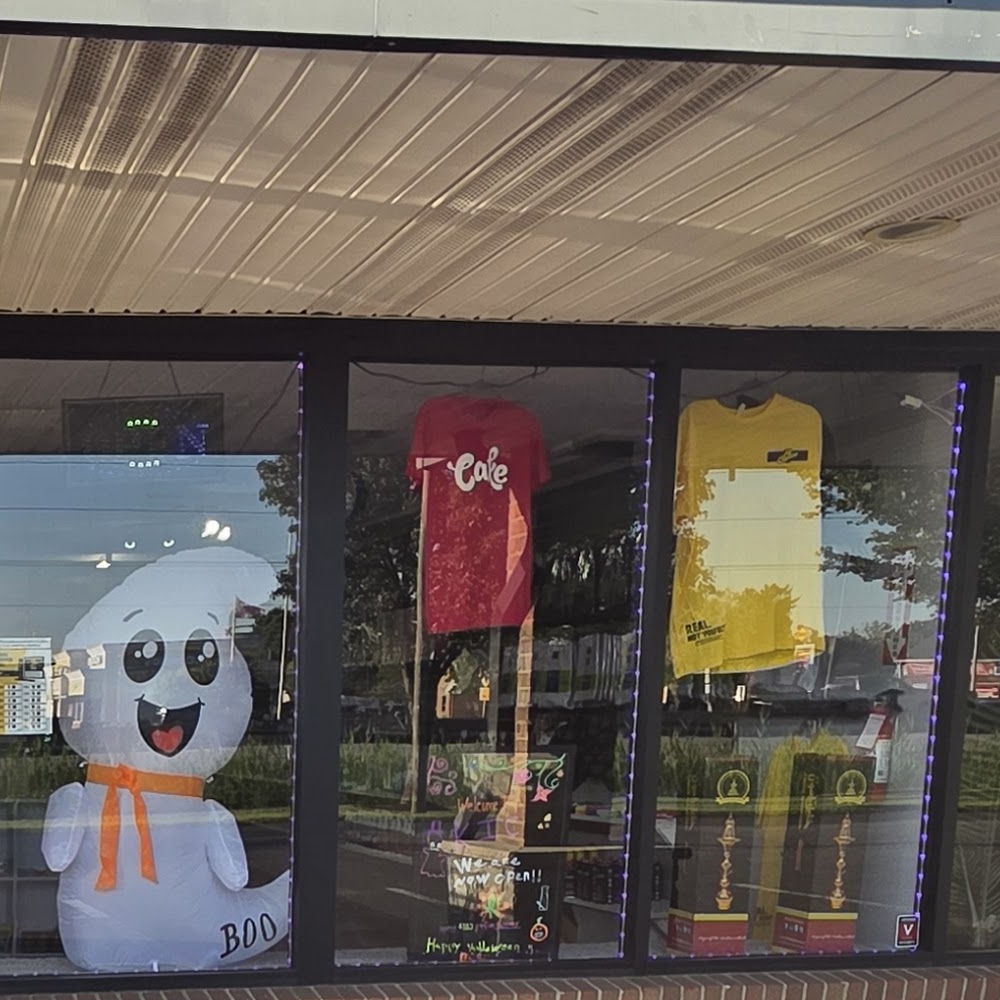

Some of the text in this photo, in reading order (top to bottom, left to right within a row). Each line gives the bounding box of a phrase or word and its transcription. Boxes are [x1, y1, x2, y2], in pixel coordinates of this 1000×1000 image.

[453, 857, 521, 874] We are
[220, 912, 277, 959] BOO
[903, 923, 915, 936] V
[426, 937, 461, 954] Happy
